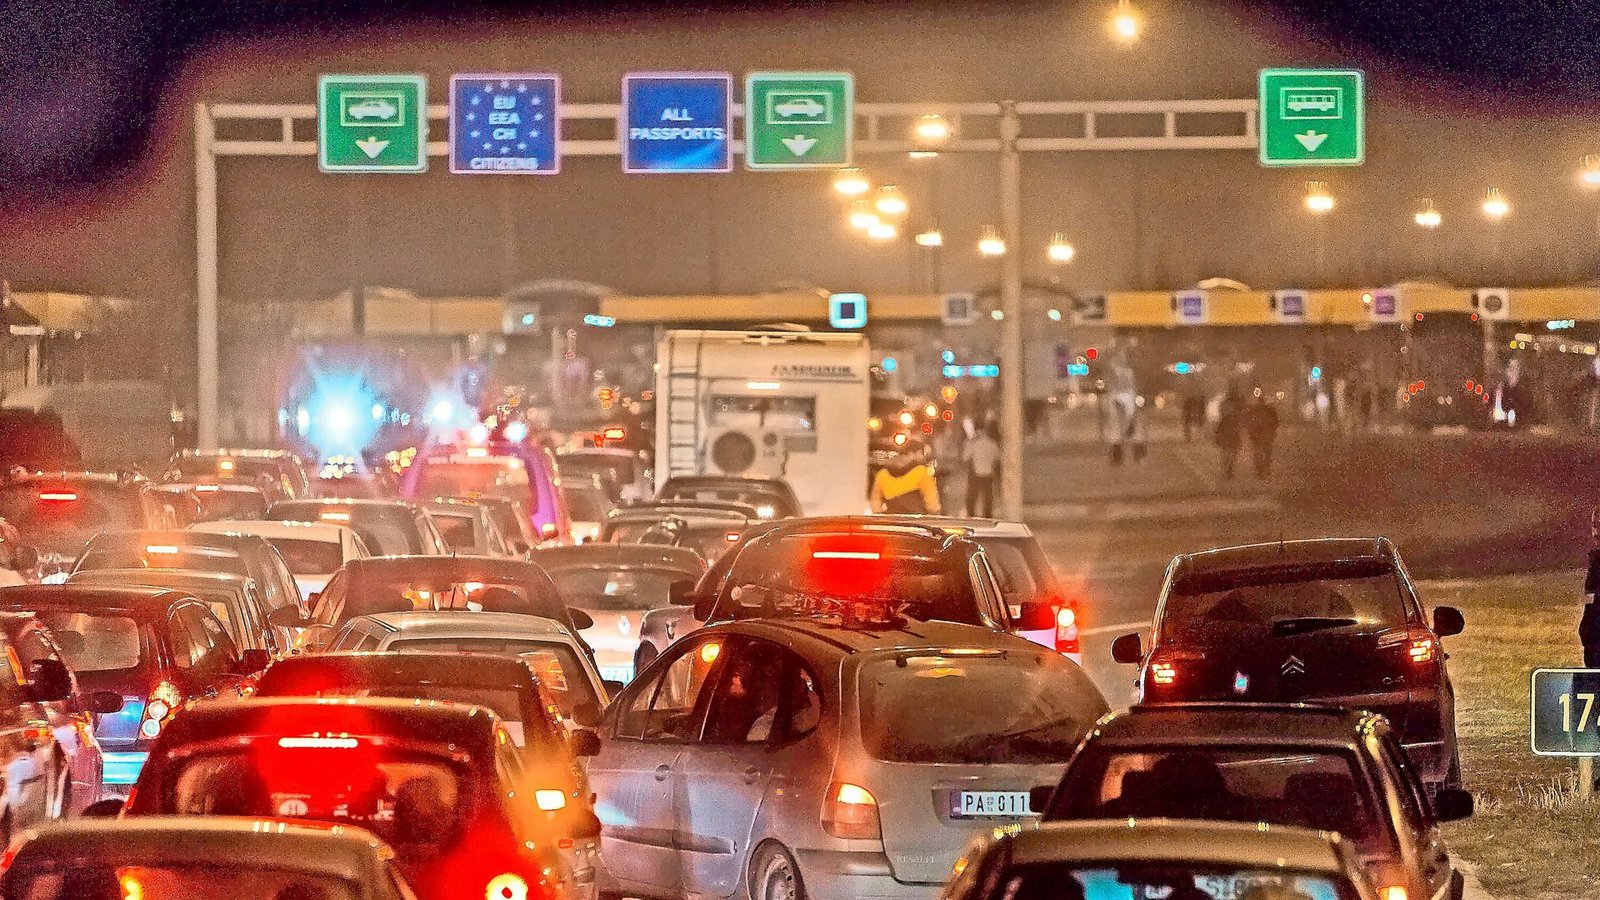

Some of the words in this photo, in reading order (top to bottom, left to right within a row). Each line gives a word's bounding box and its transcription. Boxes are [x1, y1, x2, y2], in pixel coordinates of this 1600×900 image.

[493, 95, 517, 109] EU
[488, 112, 521, 125] EEA
[661, 108, 694, 121] ALL
[492, 127, 517, 141] CH
[629, 127, 726, 141] PASSPORTS
[470, 157, 539, 170] CITIZENS
[1559, 693, 1600, 732] 17
[965, 794, 985, 812] PA
